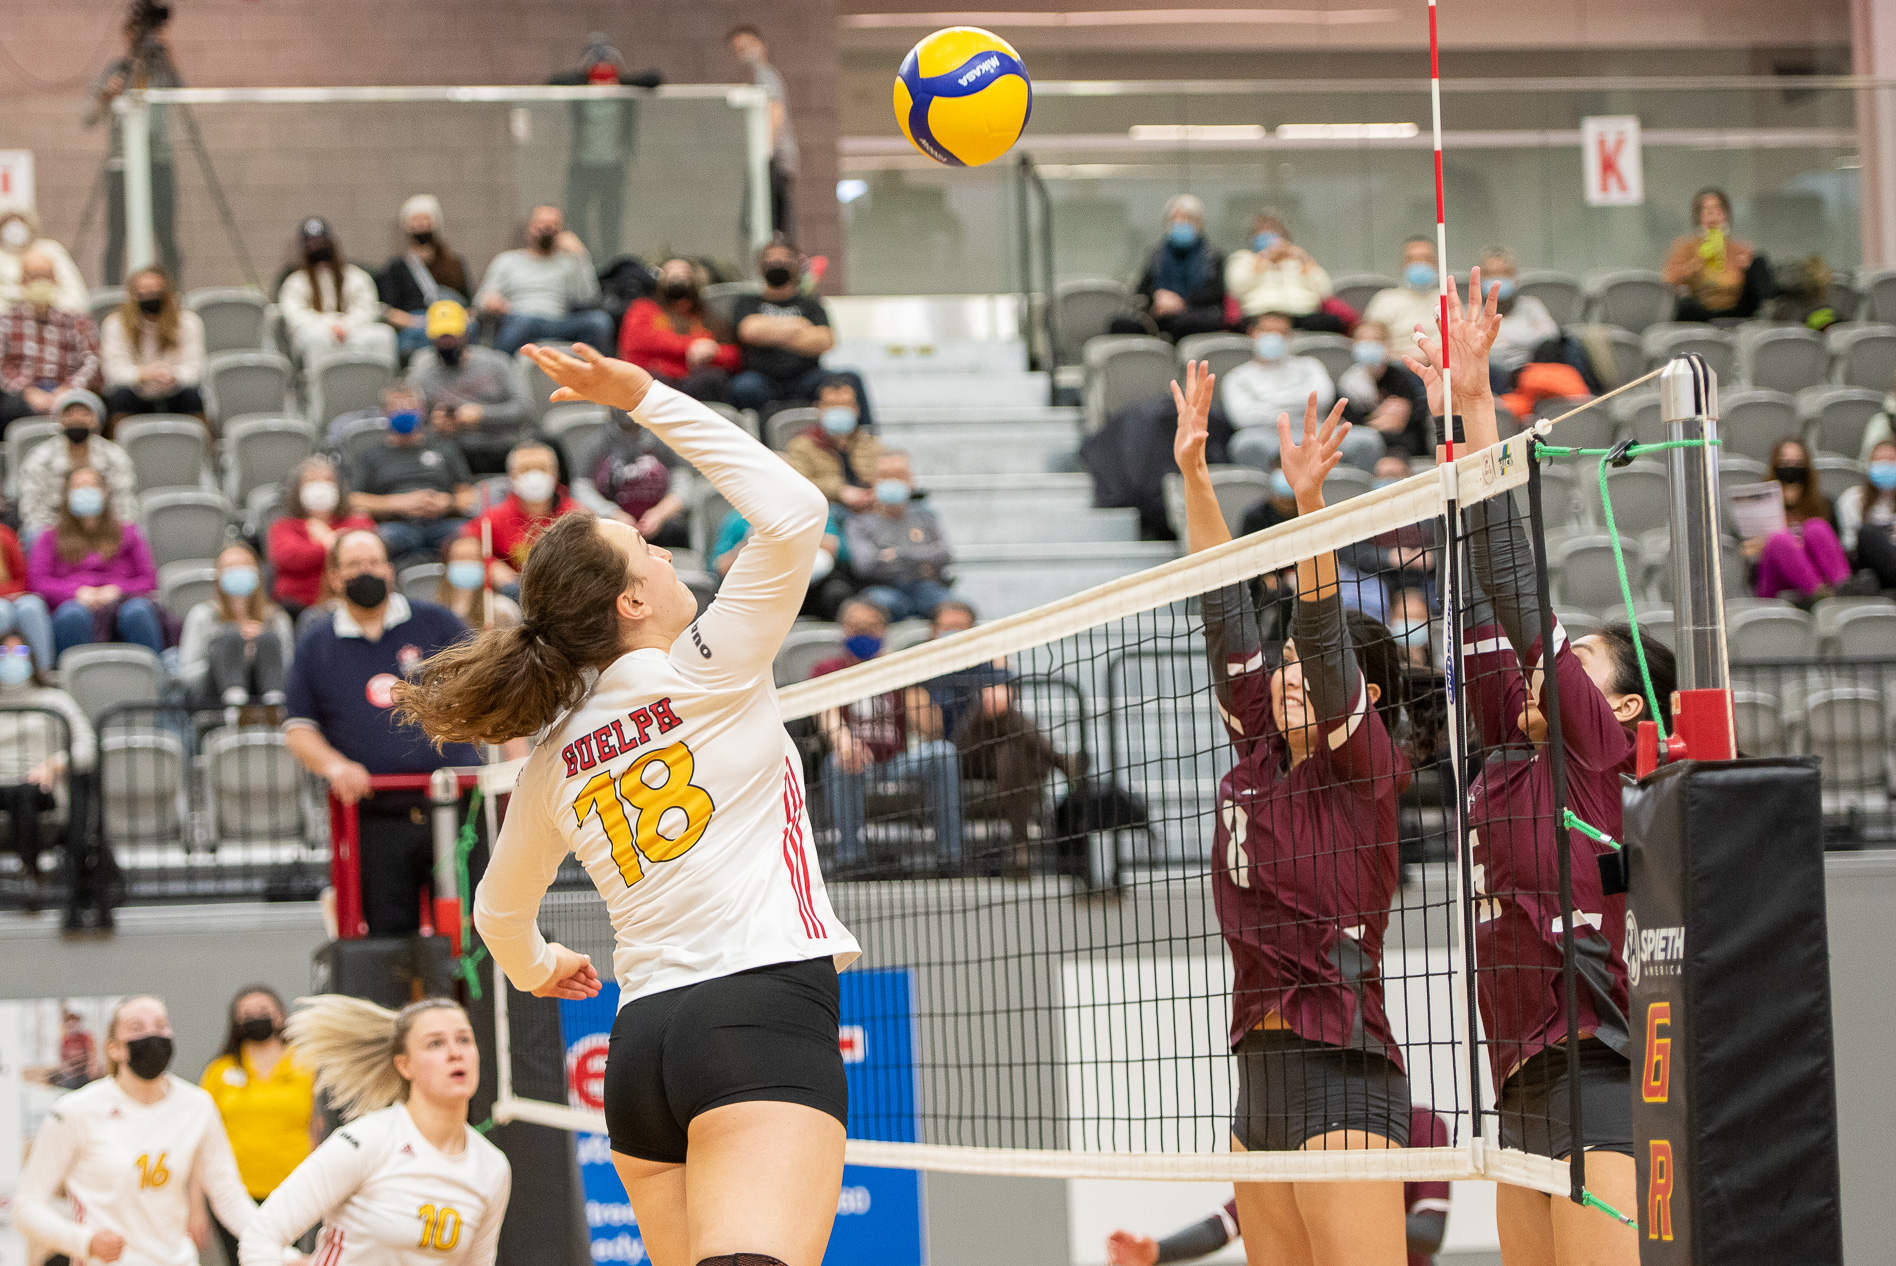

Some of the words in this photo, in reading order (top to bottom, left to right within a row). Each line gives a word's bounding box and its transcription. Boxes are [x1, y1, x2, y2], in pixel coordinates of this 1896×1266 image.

[1597, 130, 1628, 194] K
[562, 696, 684, 778] GUELPH
[572, 740, 716, 888] 18
[1640, 926, 1685, 962] SPIETH
[1644, 964, 1682, 977] AMERICA
[135, 1152, 169, 1190] 16
[417, 1203, 462, 1251] 10
